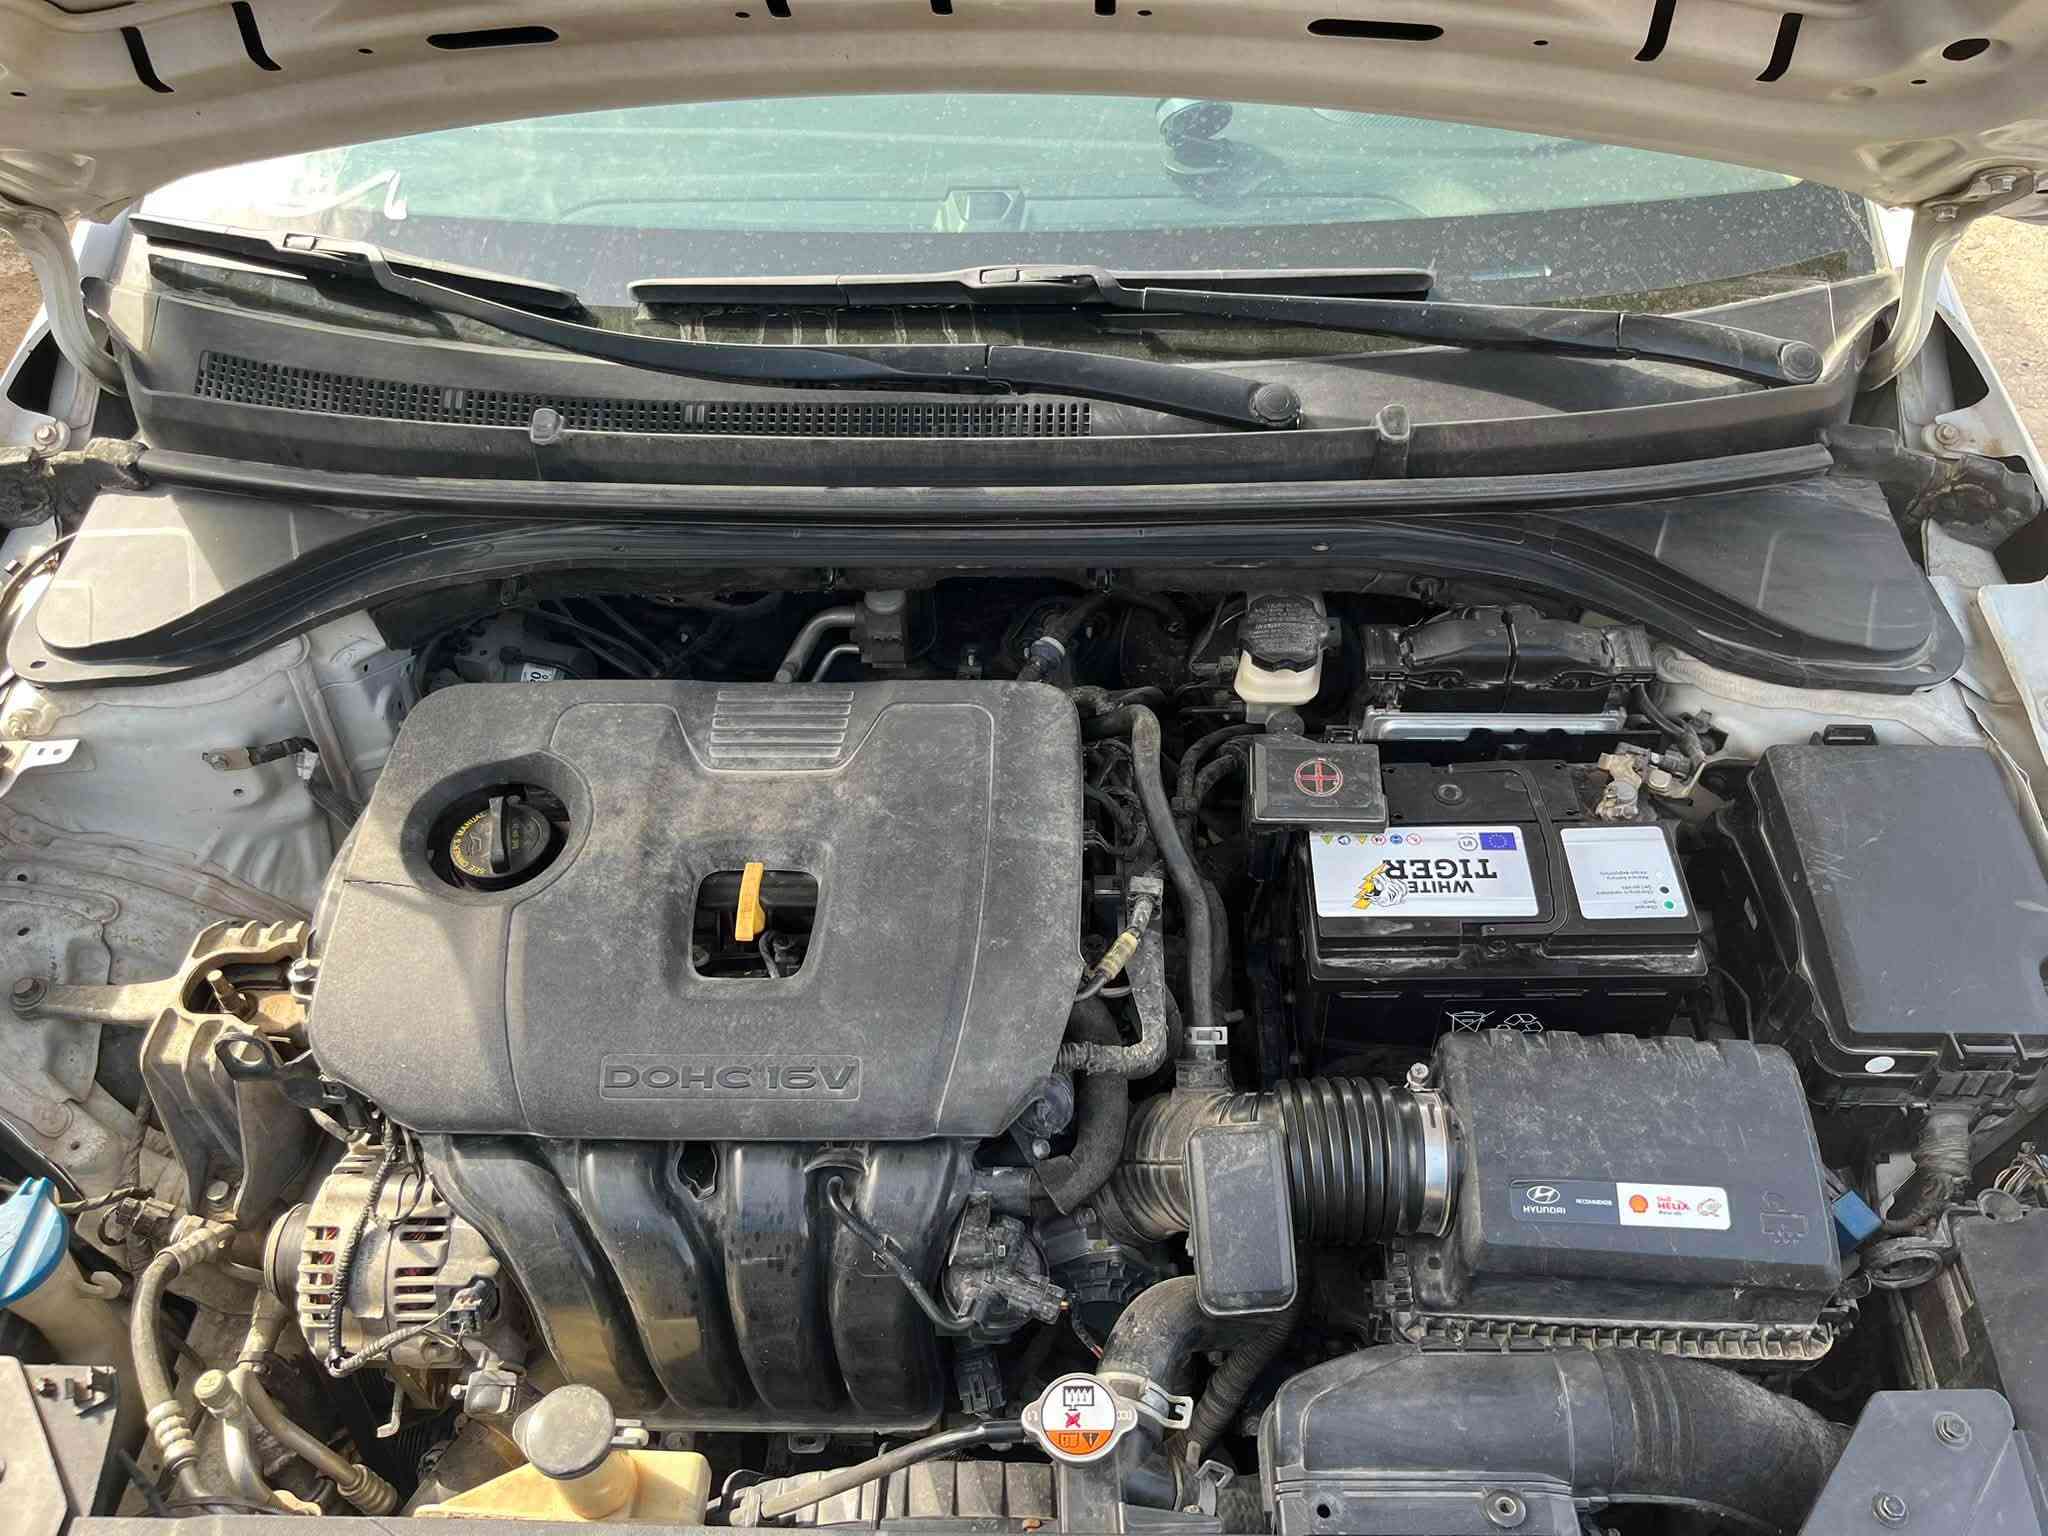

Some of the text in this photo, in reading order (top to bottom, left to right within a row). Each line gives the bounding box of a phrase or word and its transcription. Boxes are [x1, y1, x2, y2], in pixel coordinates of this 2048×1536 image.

[1382, 858, 1498, 880] TIGER
[1408, 880, 1474, 894] WHITE
[603, 1065, 857, 1091] DOHC 16V
[1522, 1204, 1567, 1216] HYUNDAI
[1656, 1201, 1691, 1211] HELIX
